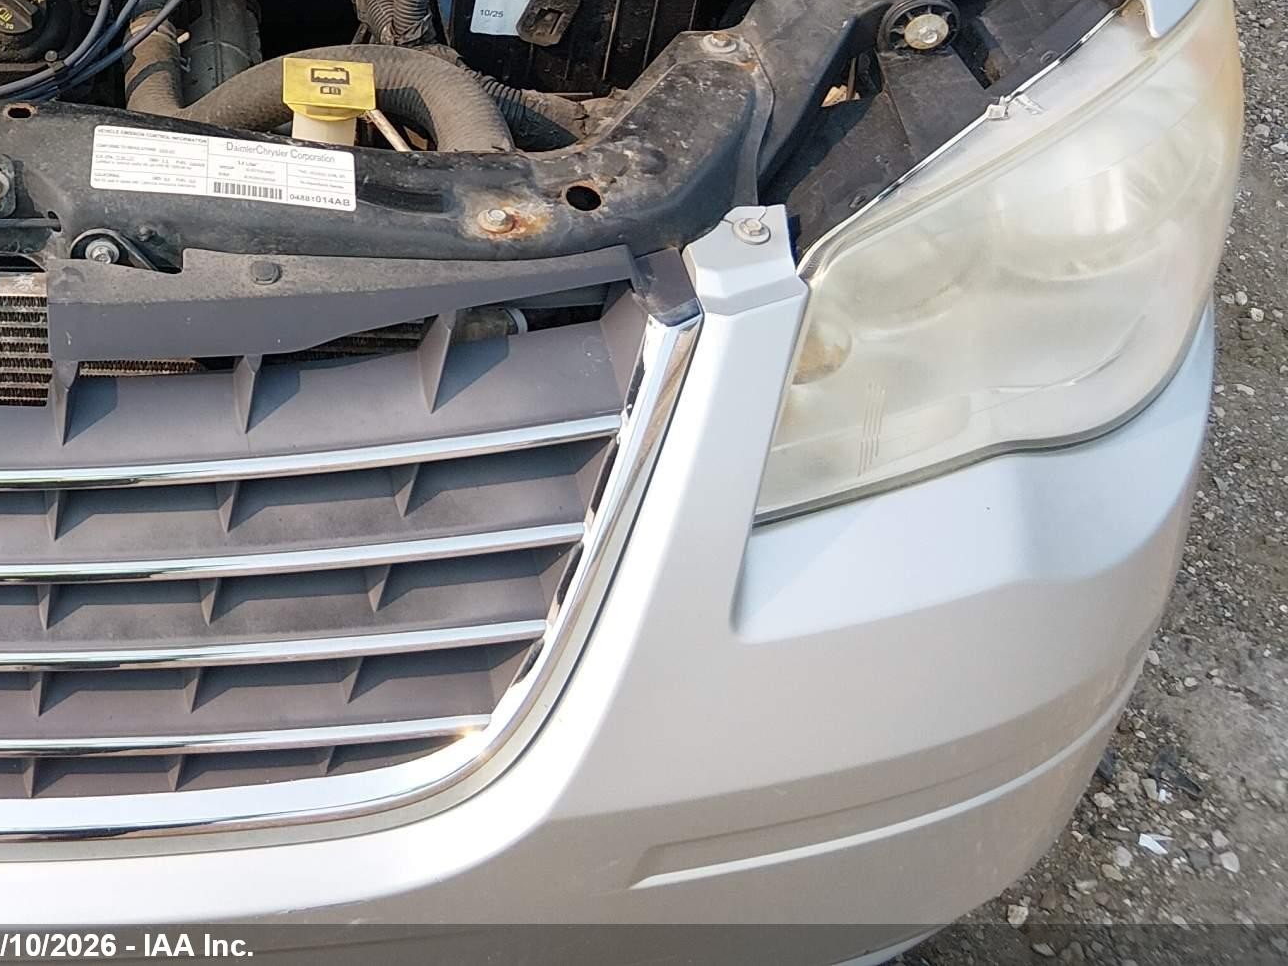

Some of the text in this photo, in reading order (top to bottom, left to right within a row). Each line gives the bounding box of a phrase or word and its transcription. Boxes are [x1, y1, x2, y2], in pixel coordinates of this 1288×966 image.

[480, 9, 504, 18] 10/25
[226, 141, 336, 163] DaimlerChrysler Corporation
